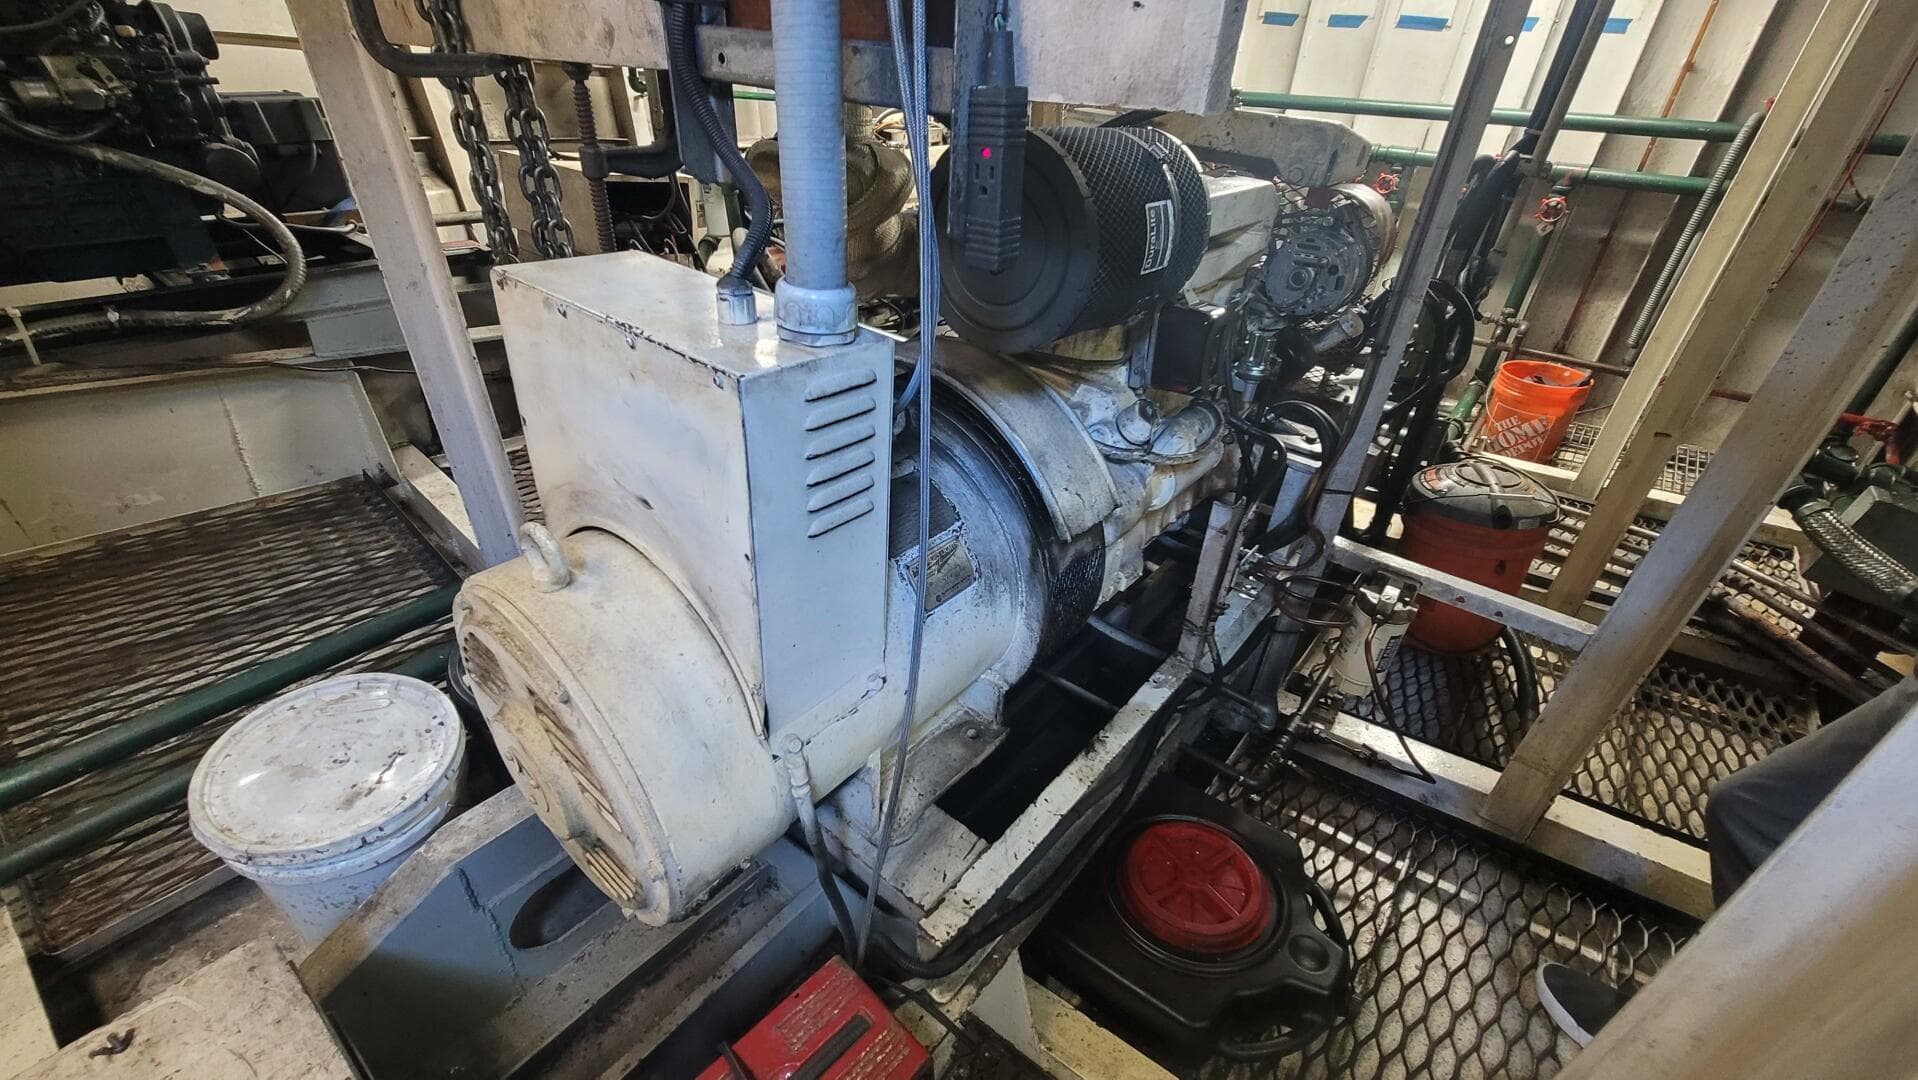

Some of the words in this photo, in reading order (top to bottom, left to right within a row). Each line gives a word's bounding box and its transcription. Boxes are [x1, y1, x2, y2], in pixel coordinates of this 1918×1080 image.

[1144, 208, 1156, 269] DuraLite
[1485, 416, 1548, 452] HOME
[1495, 415, 1521, 432] THE
